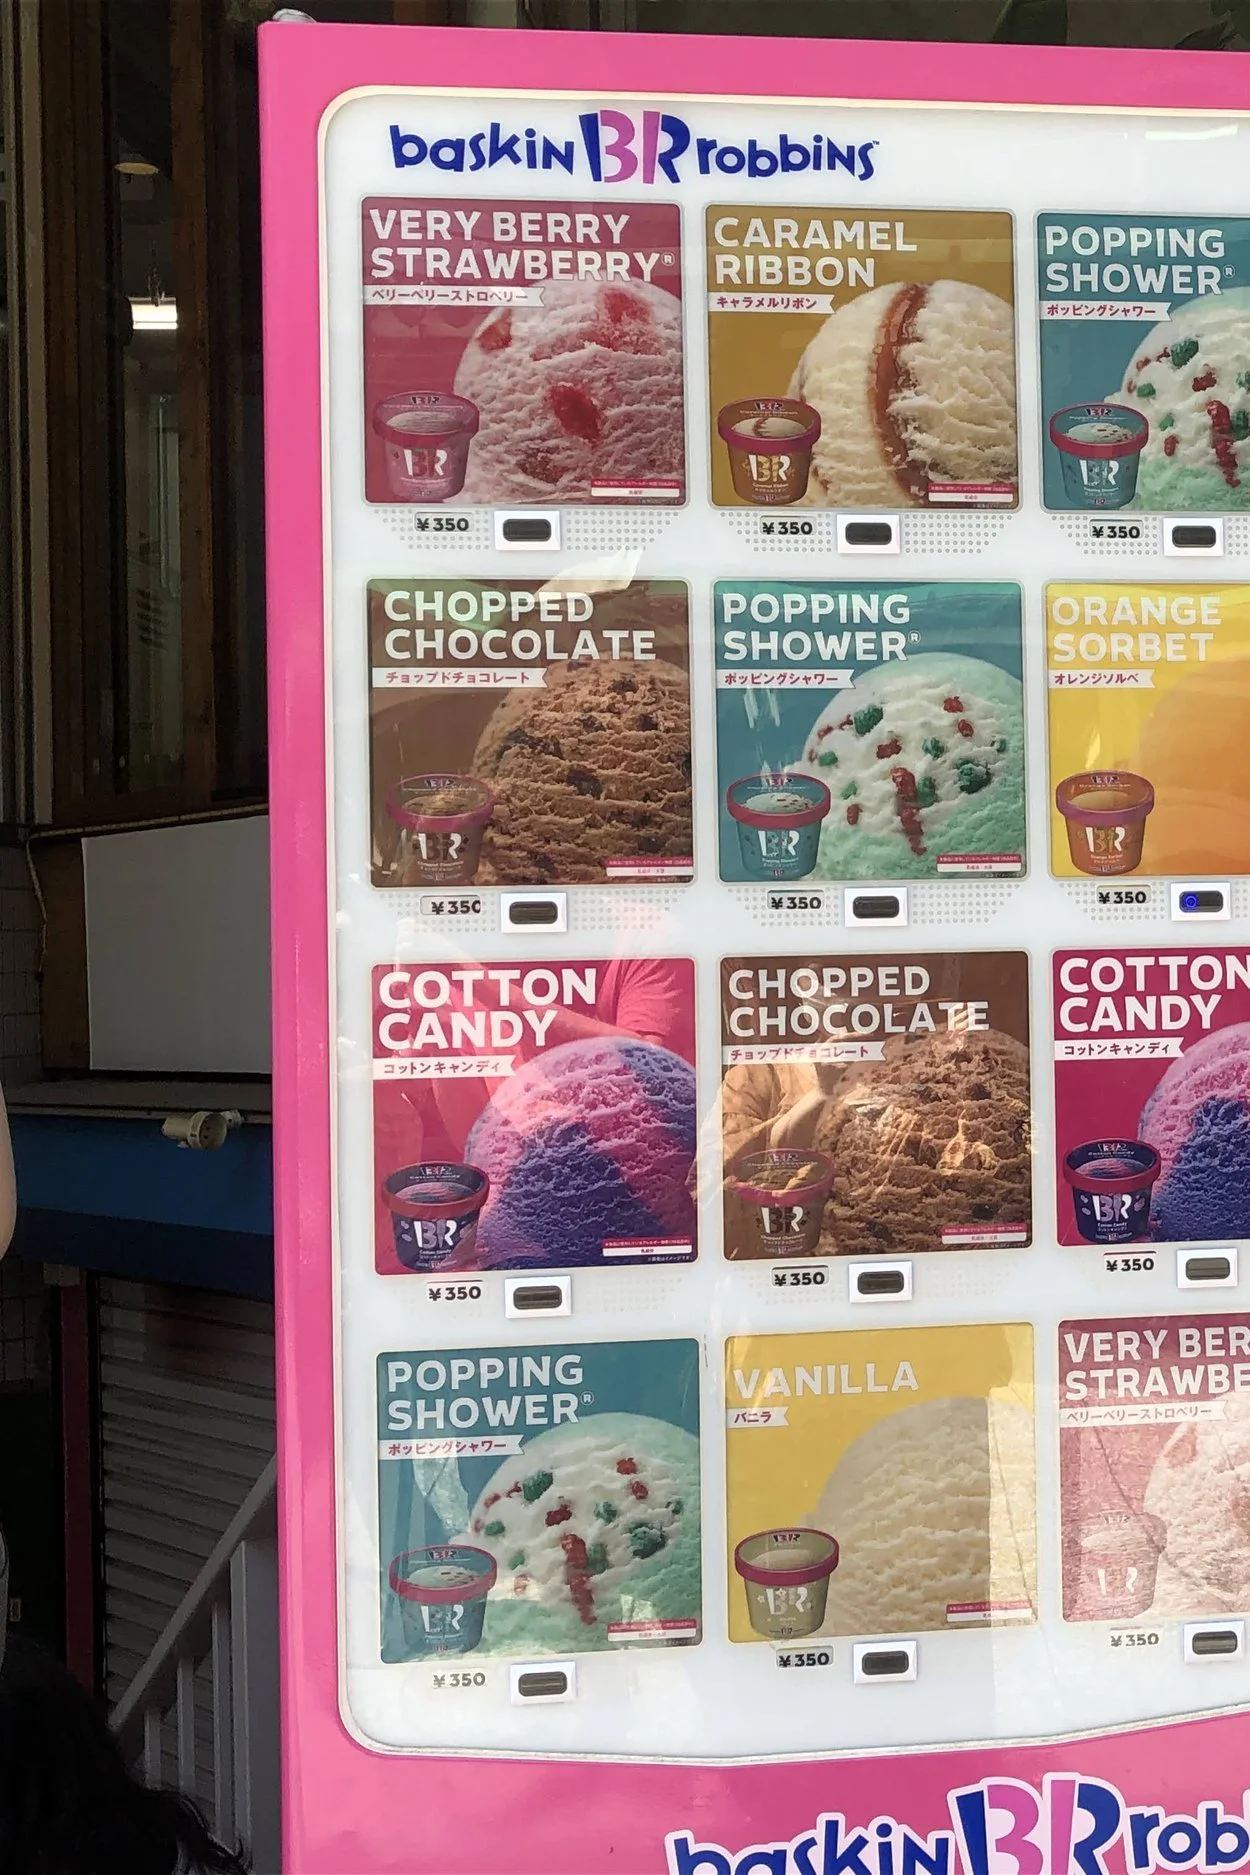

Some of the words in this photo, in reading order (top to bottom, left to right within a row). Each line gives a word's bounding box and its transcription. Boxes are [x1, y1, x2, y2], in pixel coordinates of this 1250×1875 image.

[389, 122, 576, 175] baskin
[578, 109, 692, 185] BR
[369, 208, 481, 242] VERY
[493, 210, 631, 246] BERRY
[713, 217, 918, 253] CARAMEL
[1045, 224, 1227, 260] POPPING
[714, 254, 876, 288] RIBBON
[371, 287, 530, 303] ベリーベリーストロベリー
[715, 295, 818, 310] キャラメルリボン
[1046, 303, 1157, 319] ポッピングシャワー
[416, 515, 470, 533] ¥350
[762, 520, 813, 536] ¥350
[1092, 524, 1141, 540] ¥350
[384, 590, 594, 623] CHOPPED
[723, 592, 910, 624] POPPING
[1052, 595, 1222, 627] ORANGE
[384, 628, 656, 661] CHOCOLATE
[1053, 631, 1216, 663] SORBET
[385, 671, 530, 685] チョップドチョコレート
[724, 671, 839, 687] ポッピングシャワー
[1053, 671, 1140, 687] オレンジソルベ
[771, 895, 822, 911] ¥350
[1099, 890, 1148, 906] ¥350
[378, 968, 597, 1009] COTTON
[728, 965, 931, 1000] CHOPPED
[728, 1001, 991, 1037] CHOCOLATE
[1060, 993, 1223, 1033] CANDY
[378, 1009, 560, 1050] CANDY
[730, 1045, 870, 1061] チョップドチョコレート
[1063, 1042, 1171, 1057] コットンキャンディ
[383, 1059, 500, 1075] コットンキャンディ
[1106, 1257, 1155, 1273] ¥350
[774, 1270, 826, 1287] ¥350
[428, 1285, 482, 1301] ¥350
[1064, 1328, 1170, 1364] VERY
[387, 1354, 583, 1393] POPPING
[732, 1361, 919, 1399] VANILLA
[733, 1409, 773, 1426] バニラ
[1066, 1406, 1212, 1425] ベリーベリーストロベリー
[387, 1440, 507, 1457] ポッピングシャワー
[1111, 1632, 1160, 1648] ¥350
[778, 1651, 831, 1668] ¥350
[432, 1672, 487, 1689] ¥350
